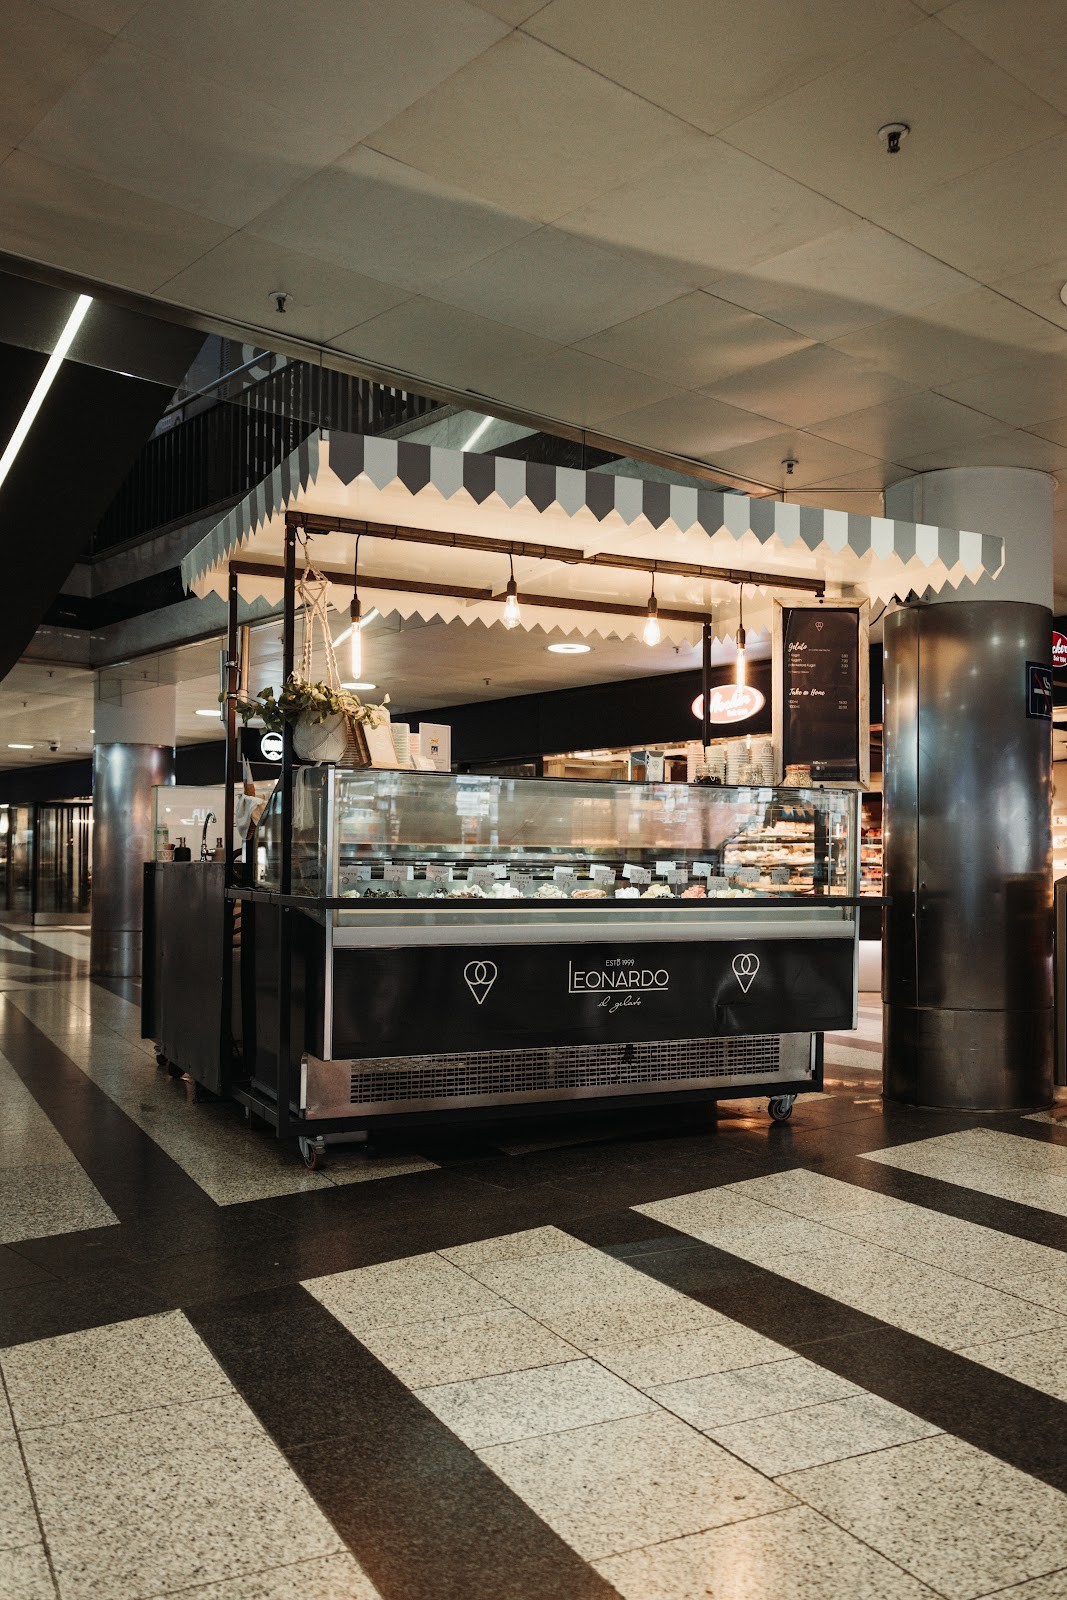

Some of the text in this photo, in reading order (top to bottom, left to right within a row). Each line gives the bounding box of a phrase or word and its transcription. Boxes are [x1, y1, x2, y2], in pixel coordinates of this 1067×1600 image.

[788, 642, 808, 652] Gelato
[789, 688, 802, 696] Take
[810, 688, 825, 696] Home
[621, 959, 635, 967] 1999
[568, 960, 669, 993] LEONARDO
[608, 995, 641, 1013] gelato
